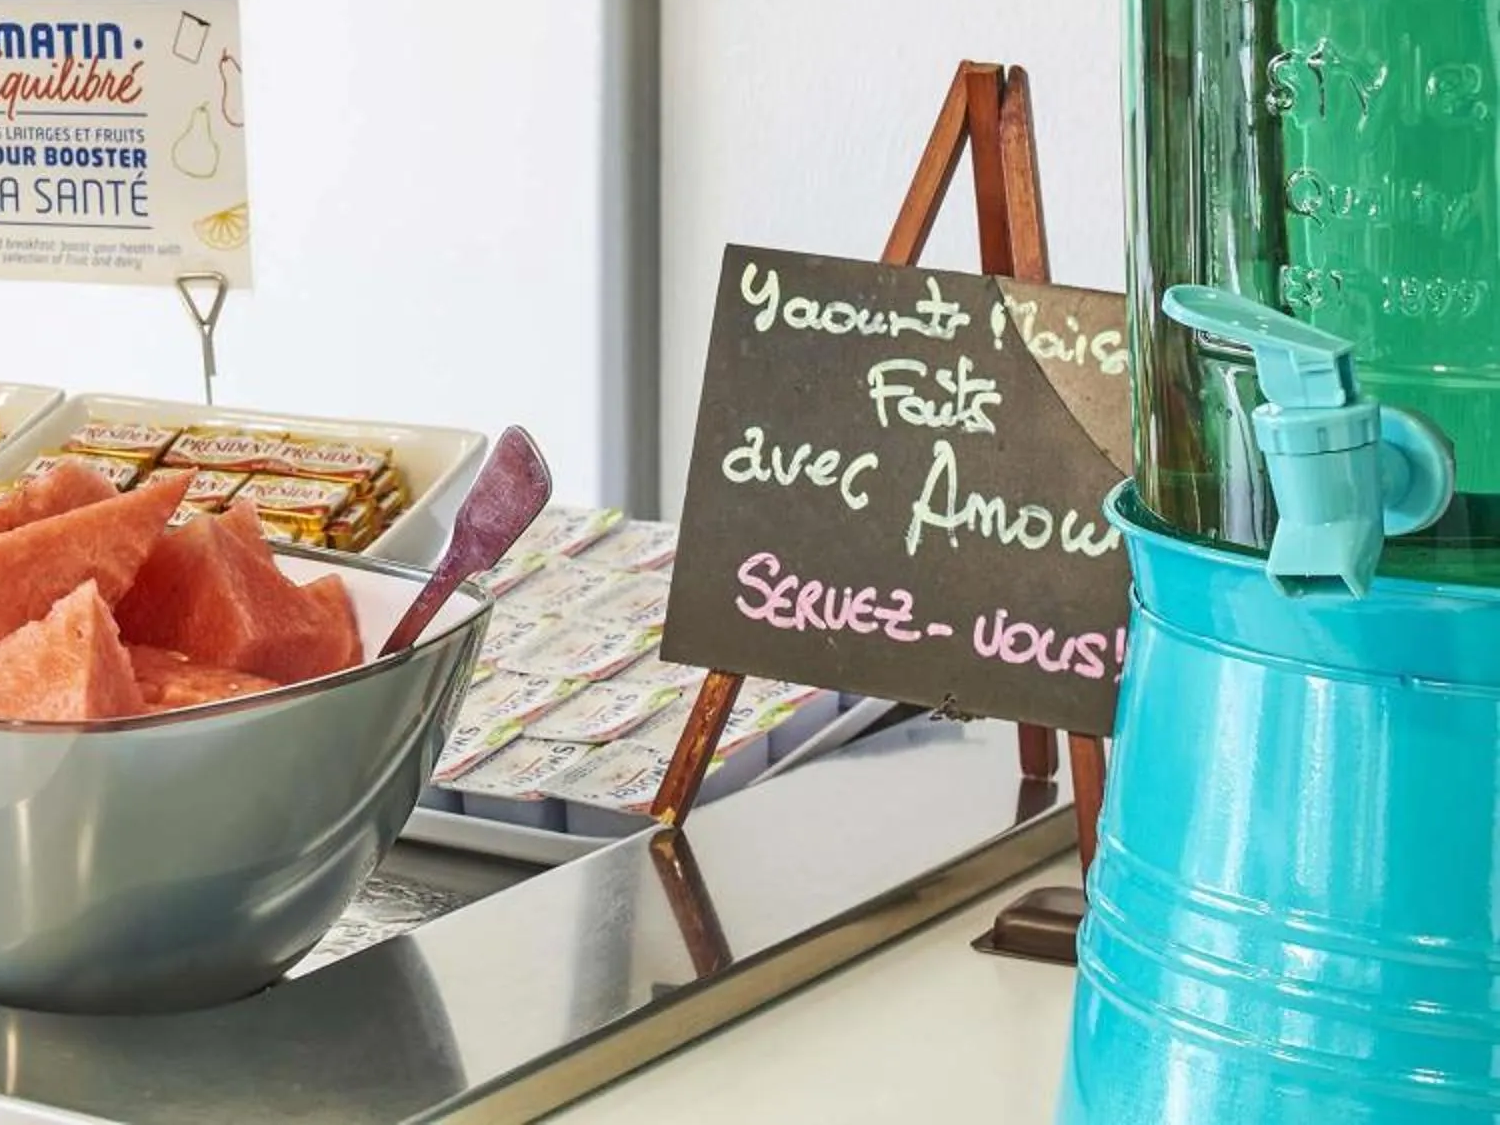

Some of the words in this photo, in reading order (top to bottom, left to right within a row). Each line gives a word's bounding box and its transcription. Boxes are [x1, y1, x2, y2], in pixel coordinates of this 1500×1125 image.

[5, 126, 71, 142] LAITAGES
[74, 128, 90, 142] ET
[95, 128, 146, 144] FRUITS
[44, 146, 148, 169] BOOSTER
[33, 171, 149, 217] SANTÉ
[990, 294, 1129, 375] Mais
[722, 426, 879, 510] avec
